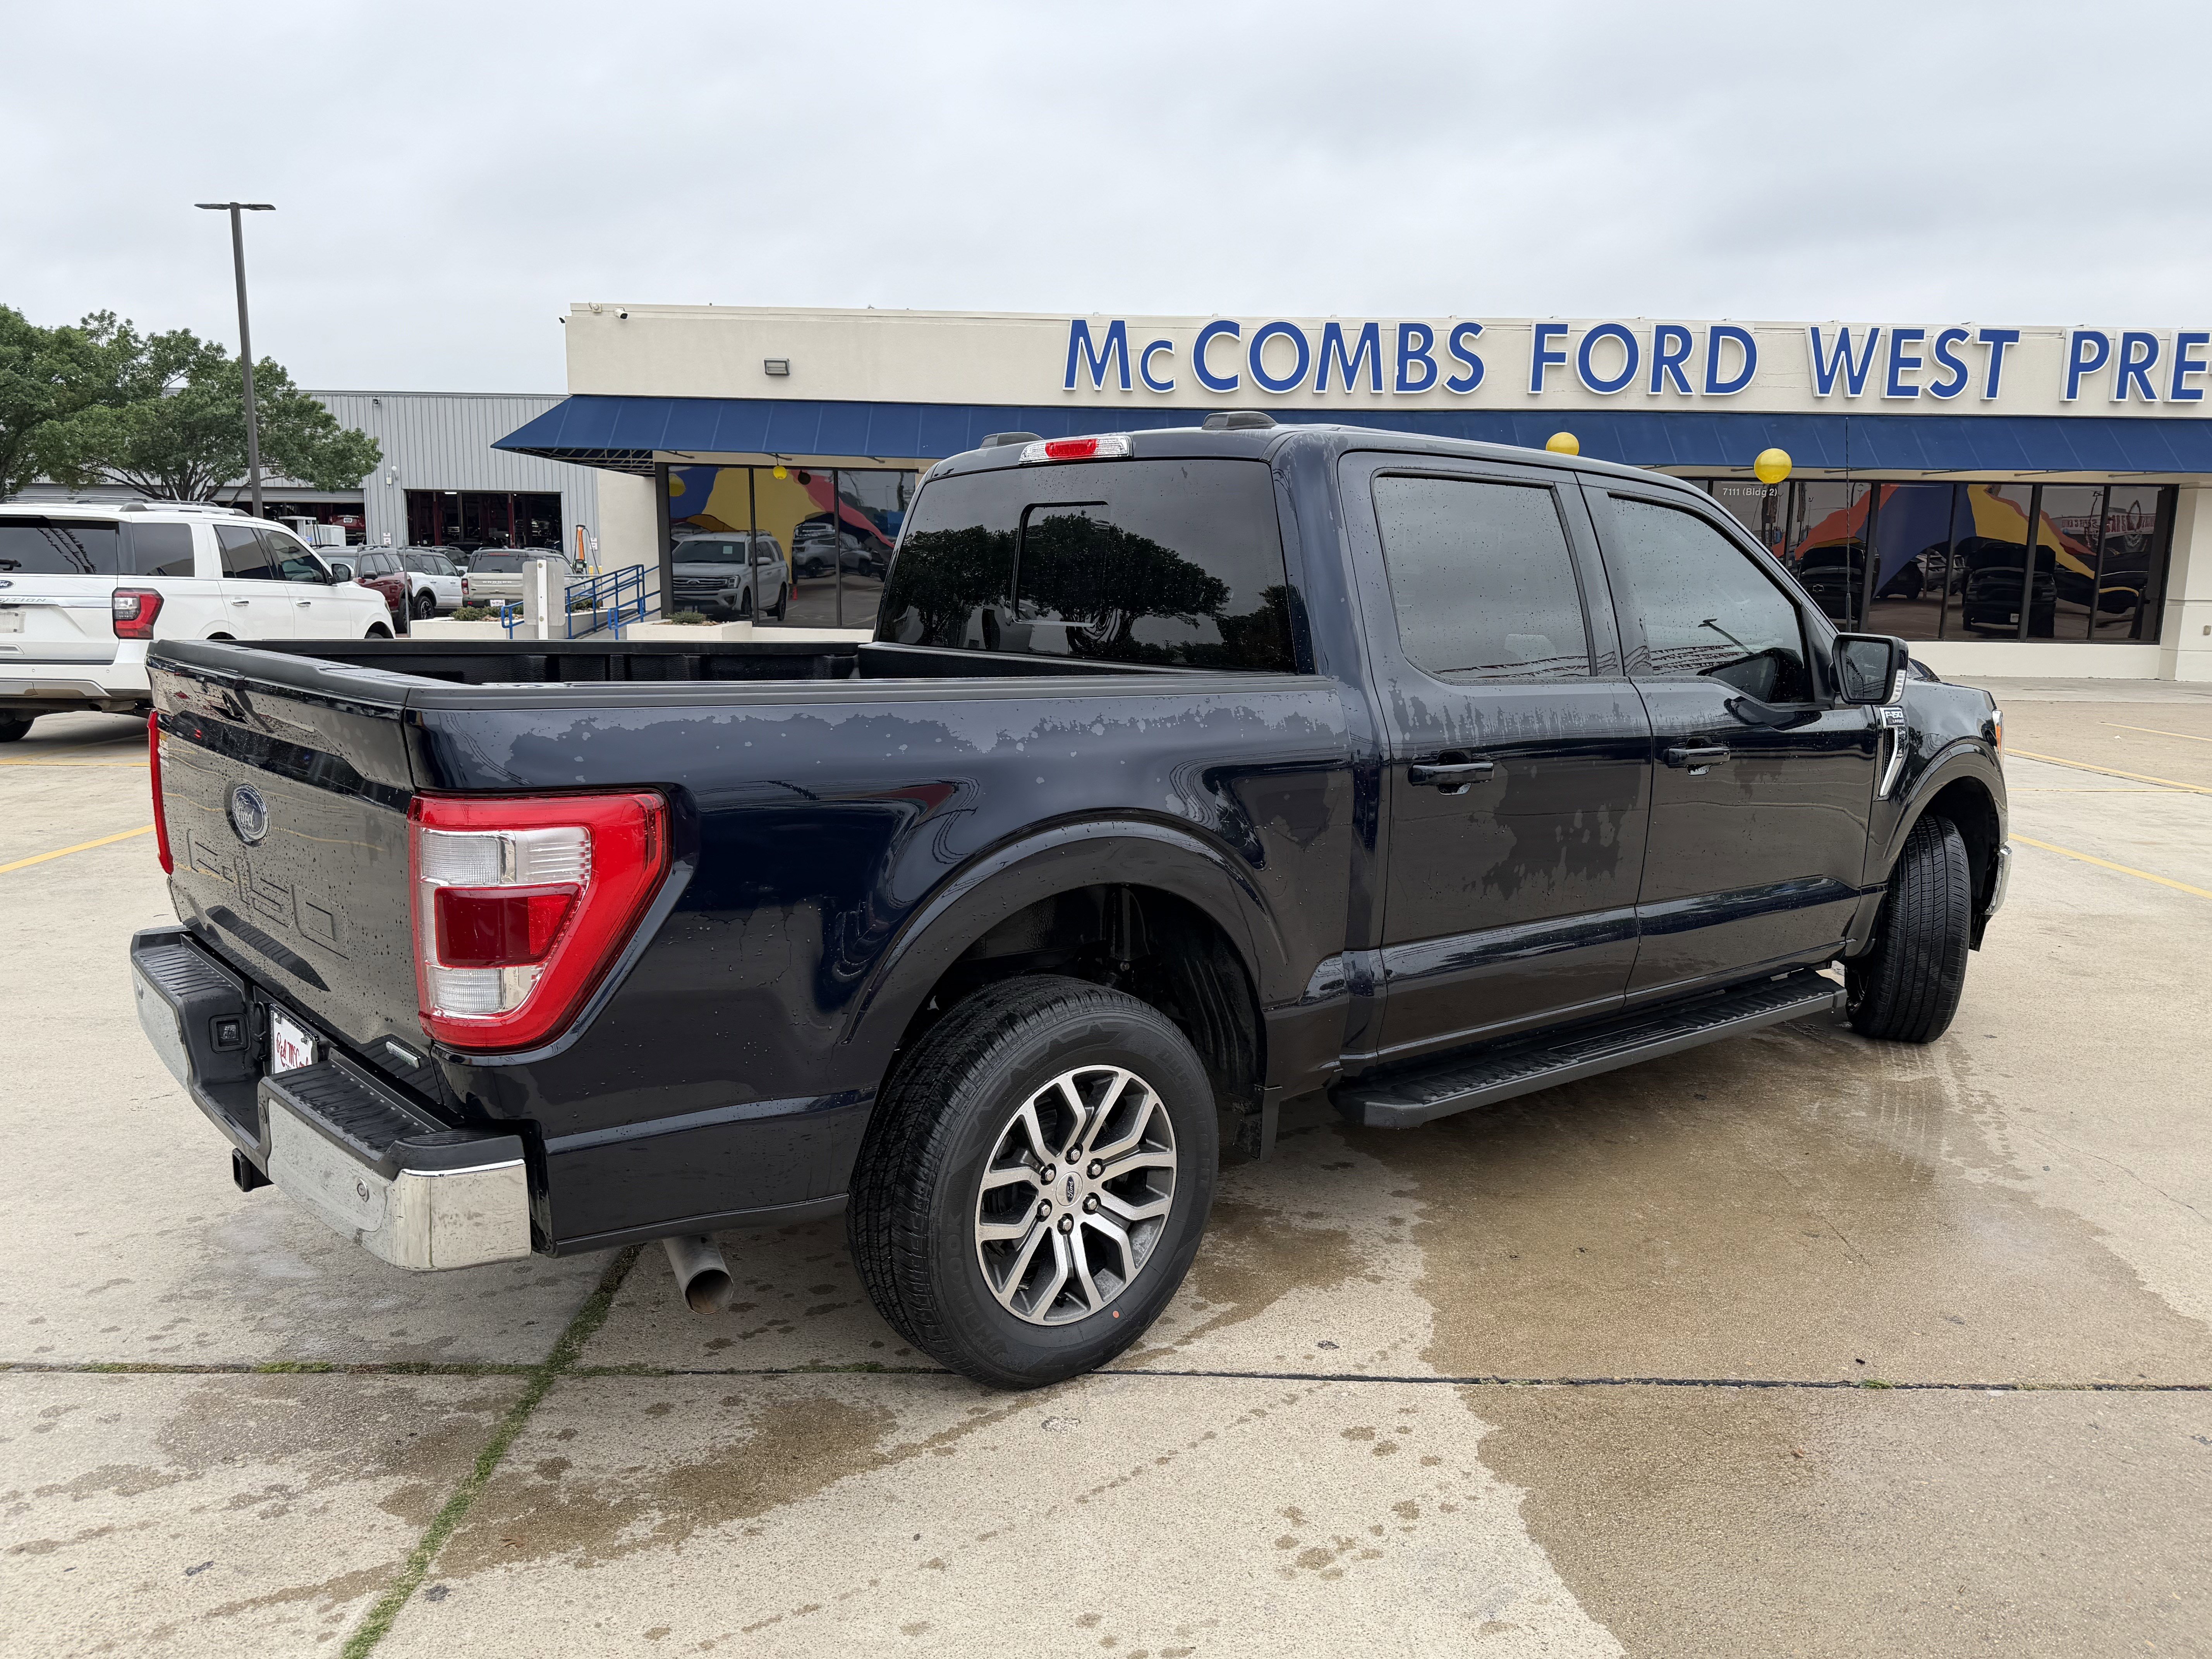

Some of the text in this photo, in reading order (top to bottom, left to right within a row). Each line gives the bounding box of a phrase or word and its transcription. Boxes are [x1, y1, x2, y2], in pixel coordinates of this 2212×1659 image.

[1064, 319, 1486, 393] McCOMBS
[1530, 323, 1757, 395] FORD
[1810, 326, 2020, 399] WEST
[1743, 488, 1767, 498] (Bldg
[1769, 488, 1778, 496] 2)
